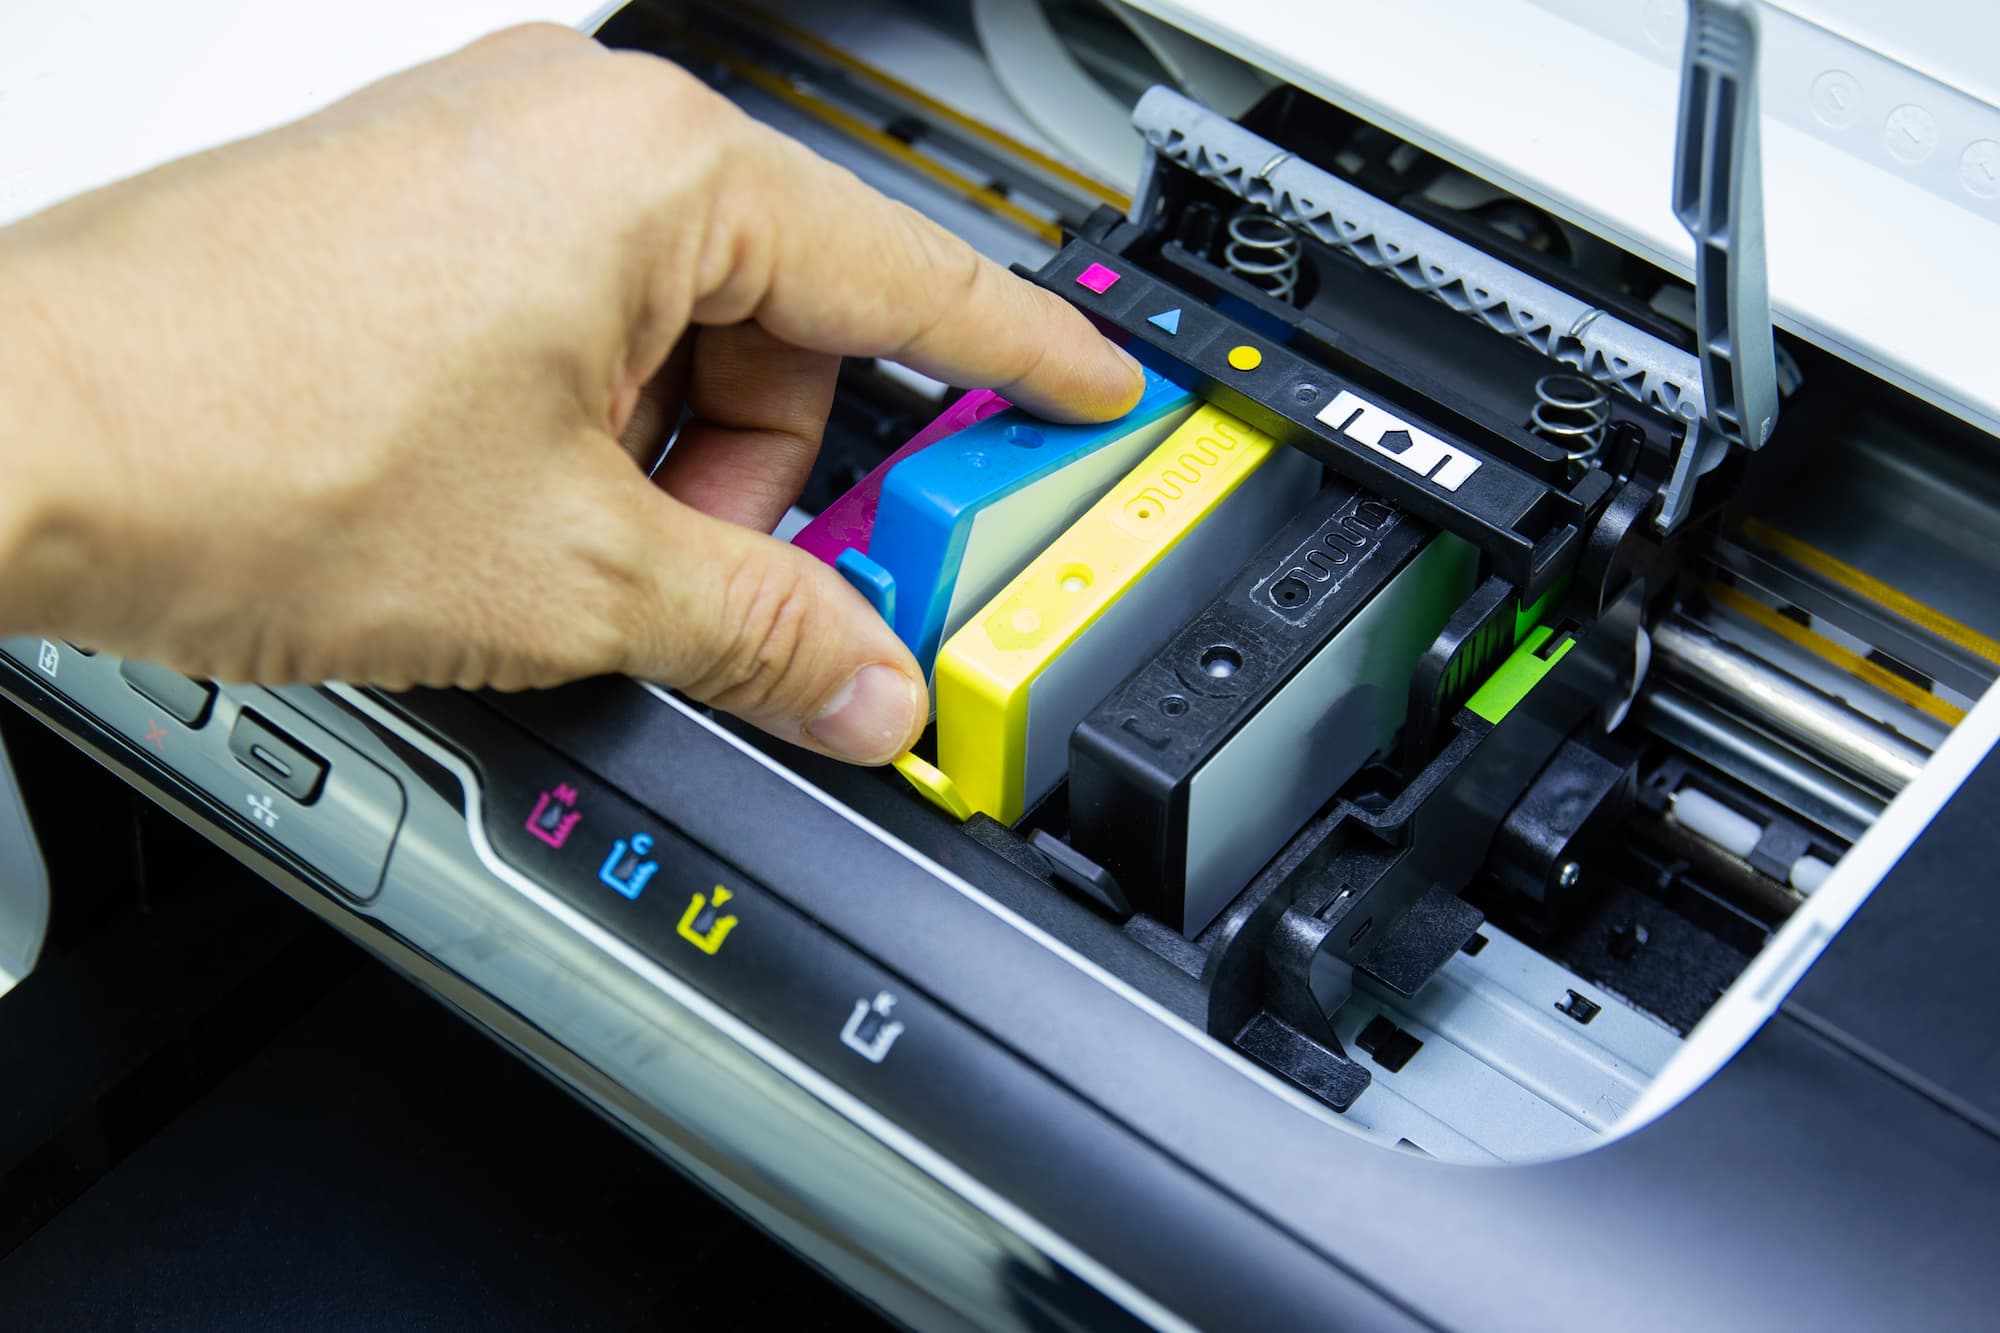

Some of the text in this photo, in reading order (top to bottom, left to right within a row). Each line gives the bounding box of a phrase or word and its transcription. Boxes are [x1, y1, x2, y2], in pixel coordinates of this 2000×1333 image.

[553, 783, 577, 807] M
[631, 832, 655, 856] C
[710, 884, 734, 908] Y
[872, 990, 897, 1016] K
